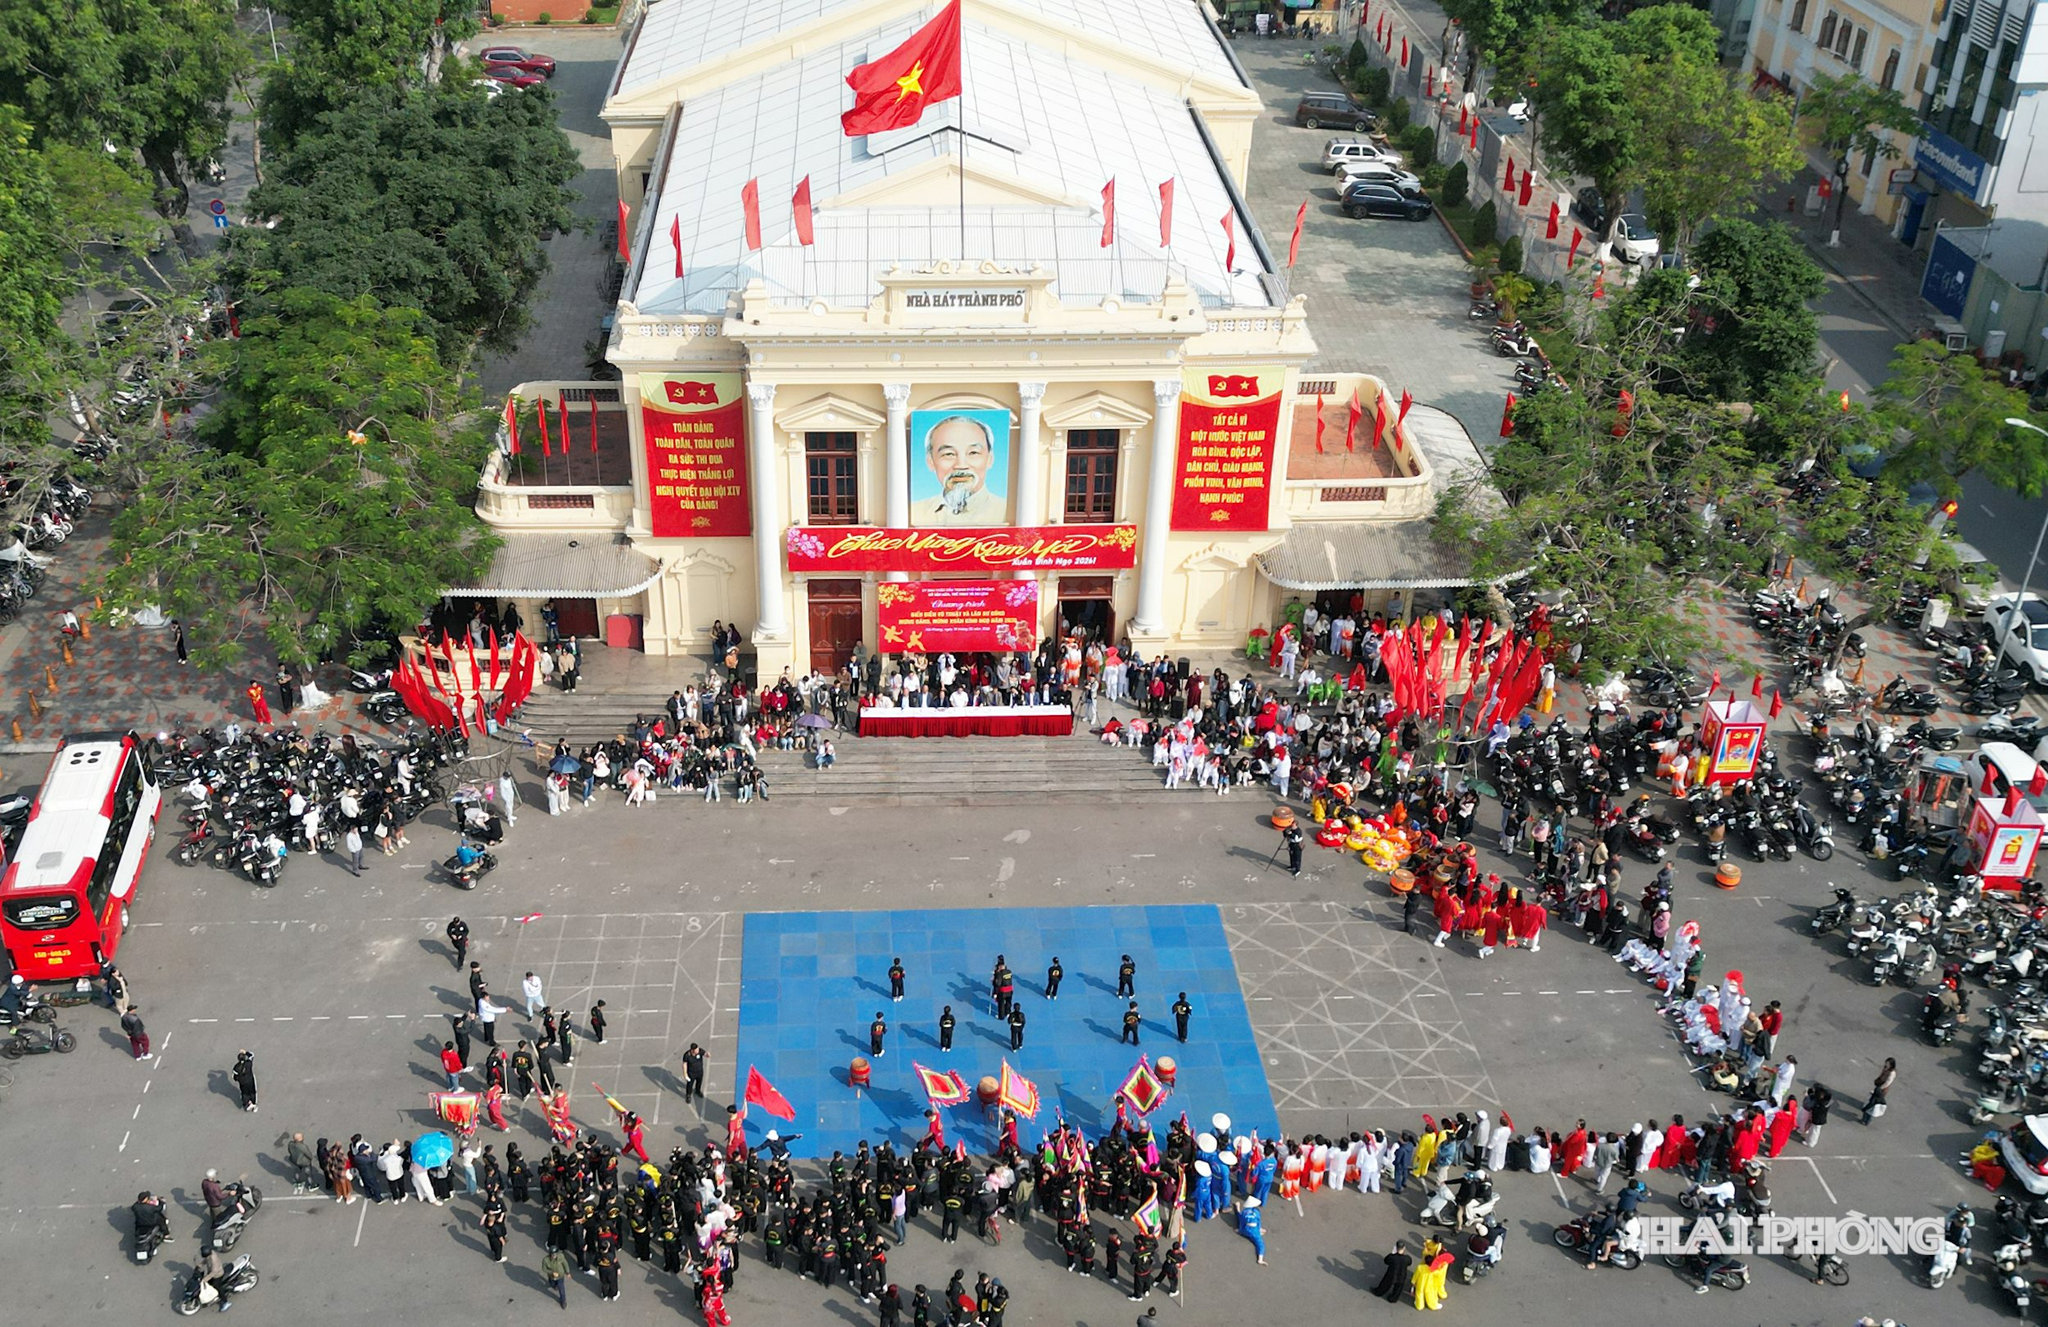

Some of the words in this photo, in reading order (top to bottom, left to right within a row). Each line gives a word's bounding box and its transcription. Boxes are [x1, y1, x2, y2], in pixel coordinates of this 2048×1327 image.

[907, 291, 931, 307] NHÀ
[933, 291, 956, 307] HÁT
[958, 290, 998, 307] THÀNH
[1000, 290, 1026, 307] PHỐ
[1213, 413, 1227, 426] TẤT
[1227, 412, 1238, 426] CẢ
[1239, 413, 1248, 426] VÌ
[672, 421, 693, 433] TOÀN
[694, 420, 714, 433] ĐẢNG
[655, 436, 674, 448] TOÀN
[694, 437, 713, 449] TOÀN
[714, 436, 735, 449] QUÂN
[1191, 429, 1208, 443] MỘT
[1208, 430, 1230, 442] NƯỚC
[1231, 429, 1247, 444] VIỆT
[1247, 430, 1266, 441] NAM
[668, 454, 679, 464] RA
[679, 452, 694, 464] SỨC
[696, 454, 707, 464] THI
[708, 454, 723, 464] ĐUA
[1230, 446, 1246, 459] ĐỘC
[1186, 460, 1202, 472] DÂN
[1222, 461, 1240, 473] GIÀU
[660, 468, 678, 481] THỰC
[679, 468, 697, 481] HIỆN
[698, 467, 721, 479] THẮNG
[723, 468, 734, 480] LỢI
[1226, 476, 1242, 488] VĂN
[656, 485, 675, 498] NGHỊ
[675, 484, 698, 497] QUYẾT
[700, 486, 712, 497] ĐẠI
[713, 485, 726, 498] HỘI
[727, 486, 741, 496] XIV
[680, 497, 695, 509] CỦA
[696, 497, 718, 509] ĐẢNG!
[1200, 493, 1220, 505] HẠNH
[1221, 492, 1244, 503] PHÚC!
[1011, 557, 1032, 566] Xuân
[1055, 557, 1072, 566] Ngọ
[1074, 556, 1097, 565] 2026!
